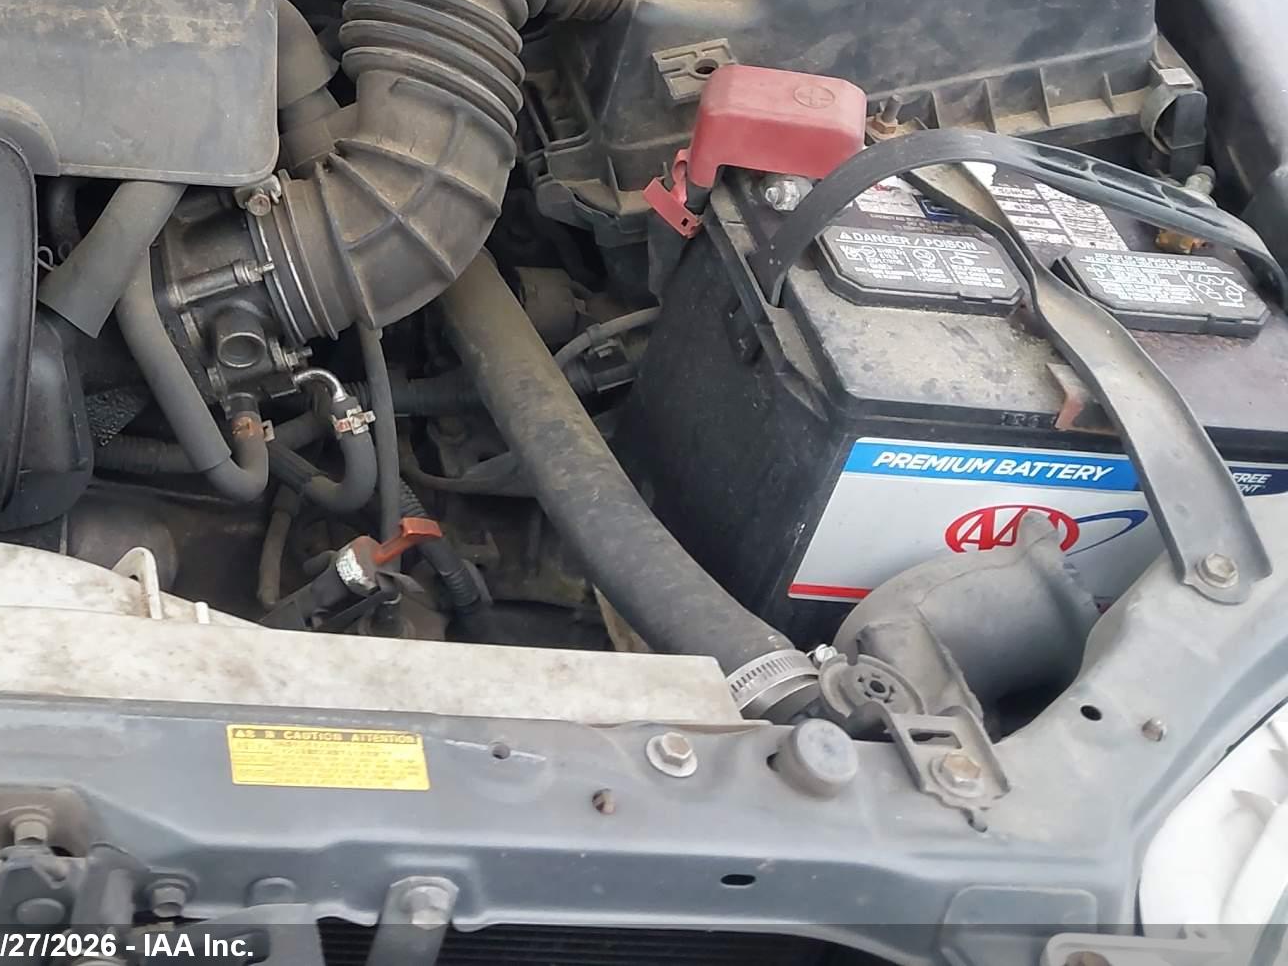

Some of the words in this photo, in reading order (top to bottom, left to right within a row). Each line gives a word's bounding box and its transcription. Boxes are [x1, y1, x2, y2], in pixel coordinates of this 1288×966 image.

[851, 232, 911, 246] DANGER
[923, 238, 978, 251] POISON
[872, 450, 997, 475] PREMIUM
[992, 458, 1115, 482] BATTERY
[1232, 472, 1272, 484] FREE
[283, 730, 343, 741] CAUTION
[351, 731, 416, 744] ATTENTION
